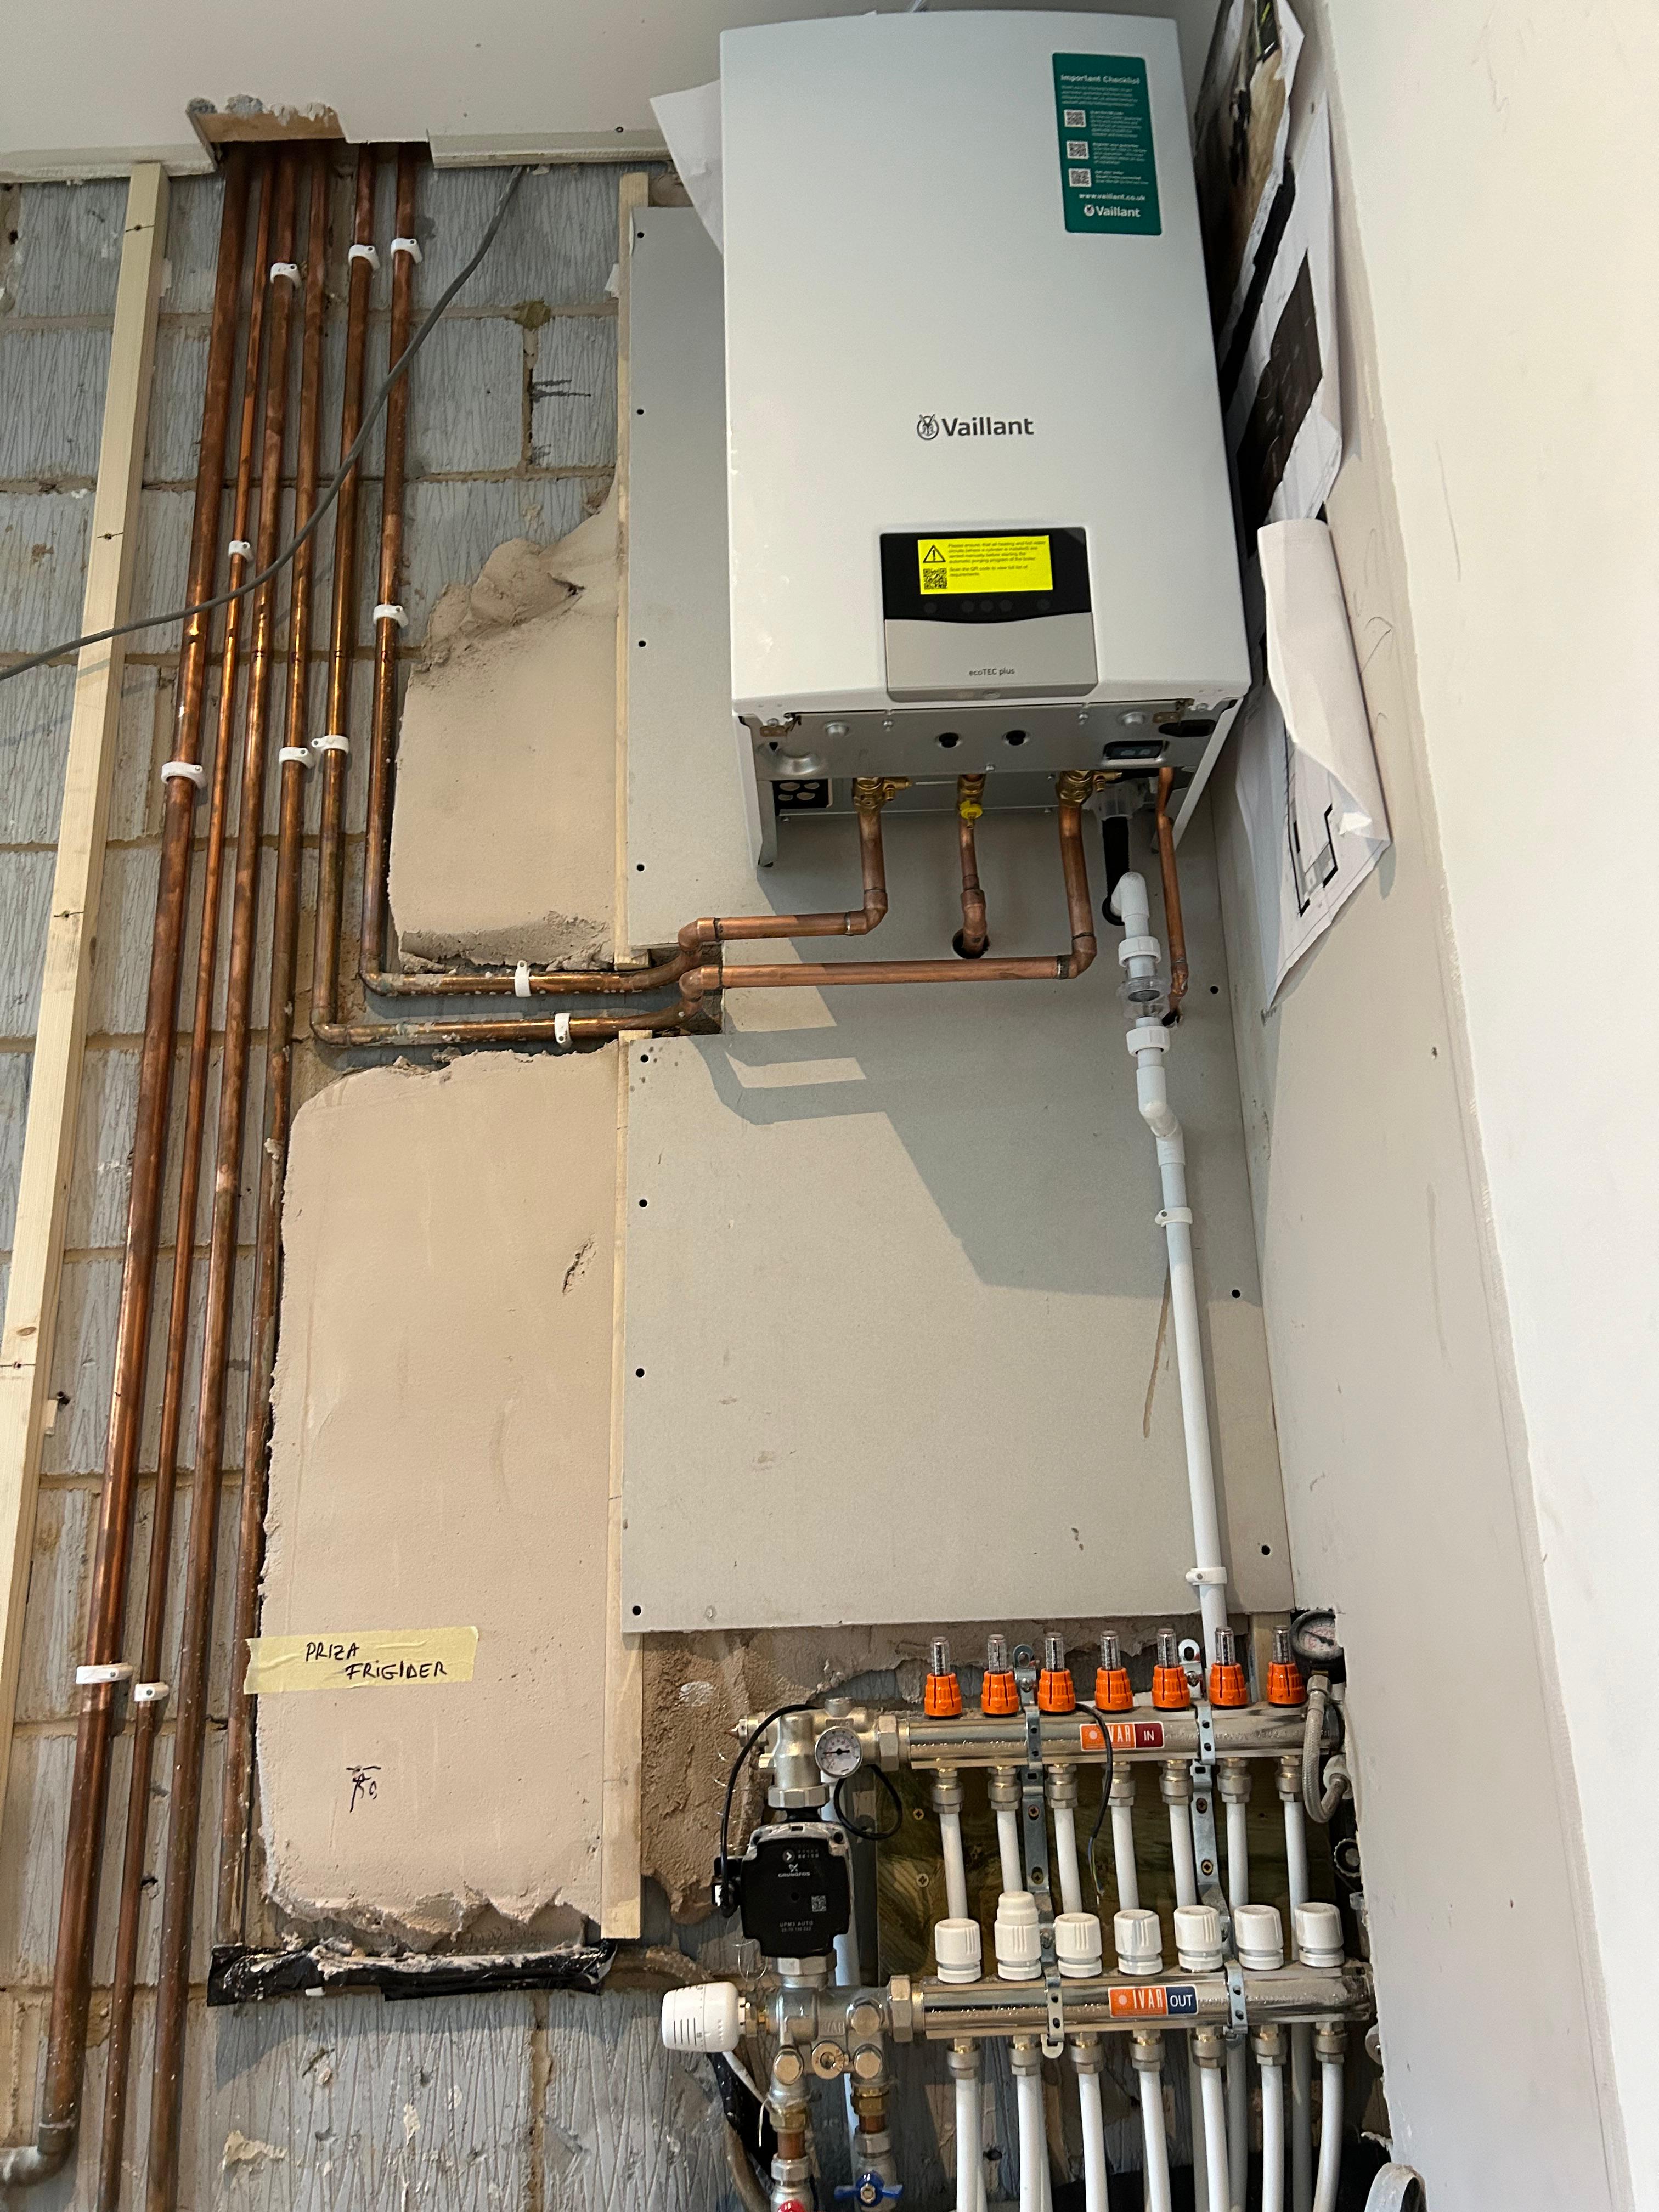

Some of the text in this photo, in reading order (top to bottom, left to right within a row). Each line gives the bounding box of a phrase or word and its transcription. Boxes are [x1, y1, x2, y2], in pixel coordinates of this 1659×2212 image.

[1095, 205, 1141, 218] Vaillant
[941, 416, 1034, 436] Vaillant
[969, 667, 1015, 677] ecoTEC plus
[305, 1641, 359, 1662] PRIZA
[1106, 1725, 1155, 1743] VAR IN
[1132, 1988, 1163, 2010] IVAR
[1169, 1994, 1193, 2008] OUT
